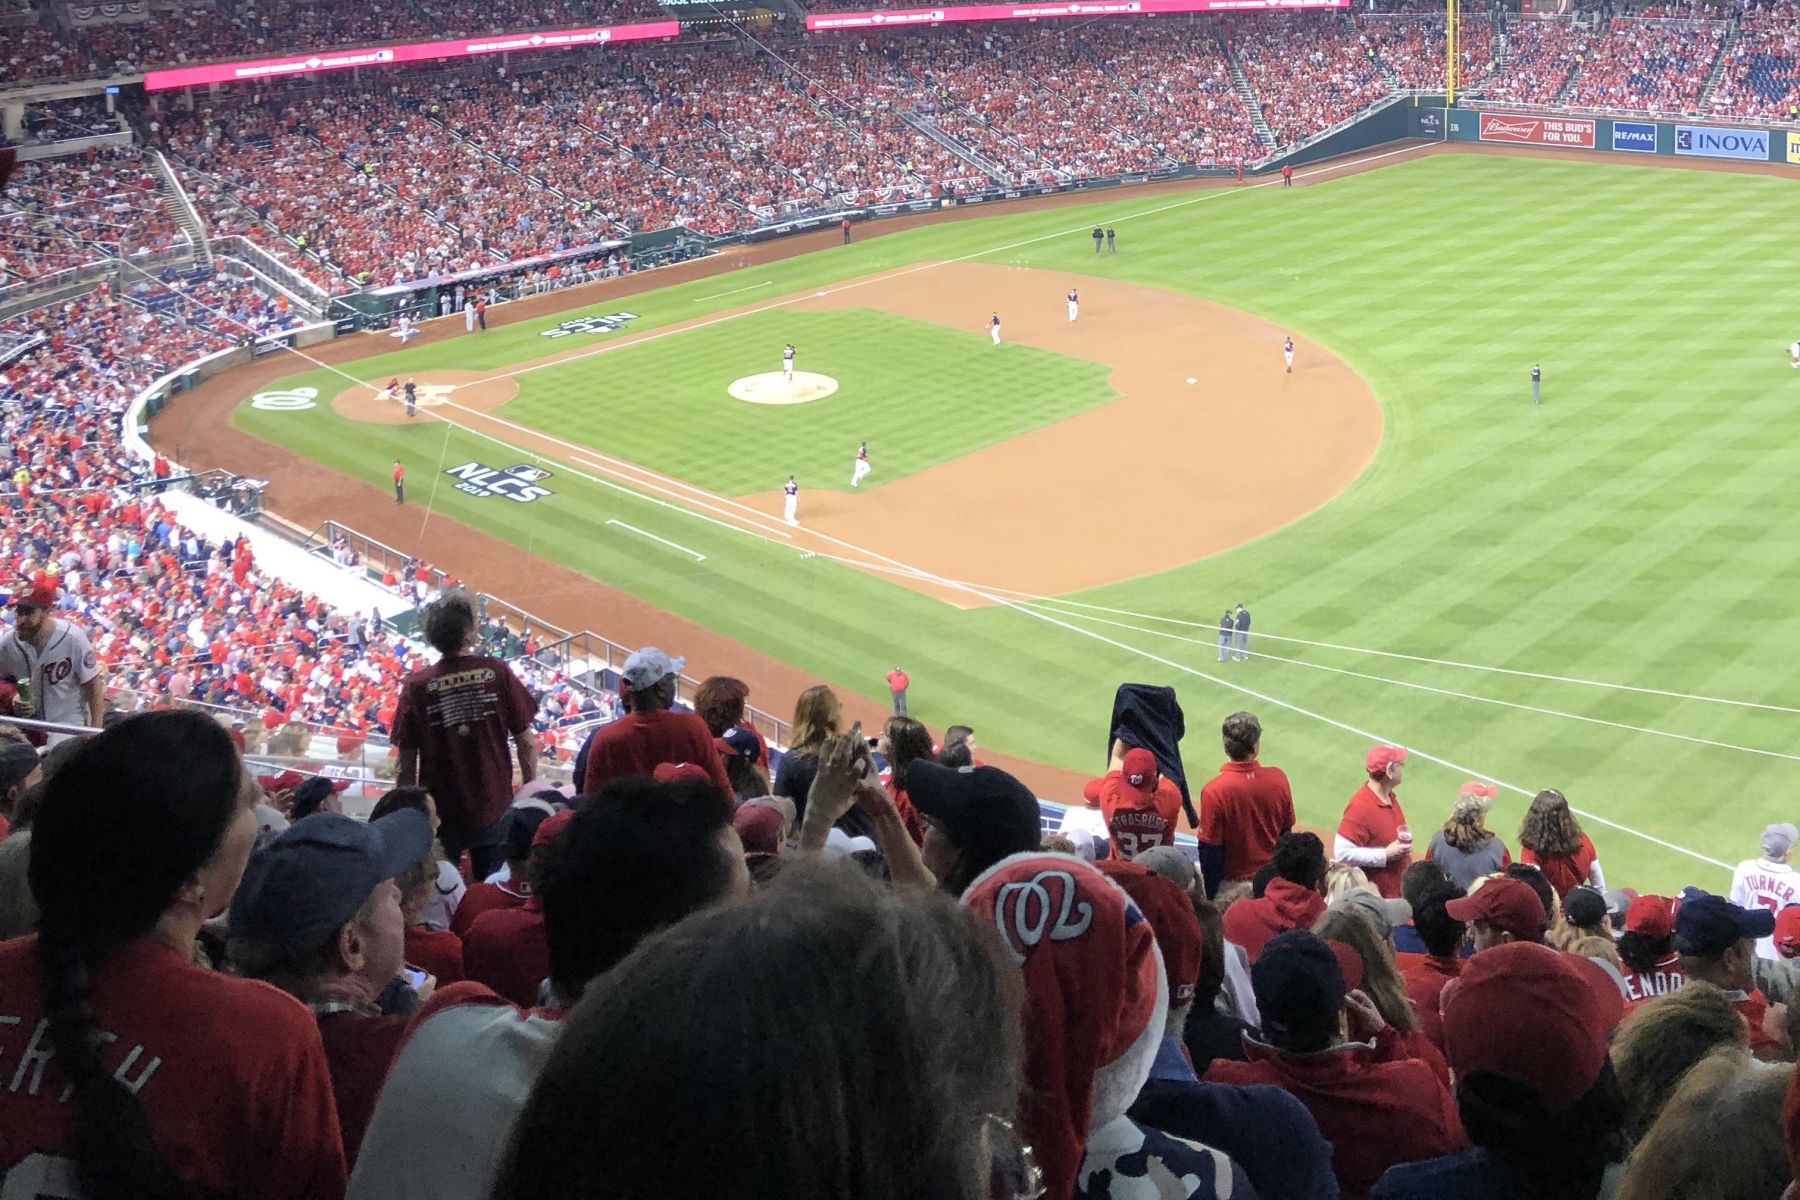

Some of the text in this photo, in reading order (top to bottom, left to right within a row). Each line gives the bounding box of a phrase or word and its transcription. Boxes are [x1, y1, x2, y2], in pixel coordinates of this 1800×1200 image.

[1488, 120, 1533, 134] Budweiser
[1543, 121, 1592, 134] THIS BUD'S
[1543, 131, 1583, 143] FOR YOU.
[1615, 130, 1654, 142] RE/MAX
[1700, 134, 1766, 153] INOVA
[445, 462, 552, 502] NLCS
[454, 482, 492, 497] 2019
[1116, 831, 1163, 861] 37
[1744, 875, 1795, 902] TURNER
[1623, 971, 1682, 1000] ENDO
